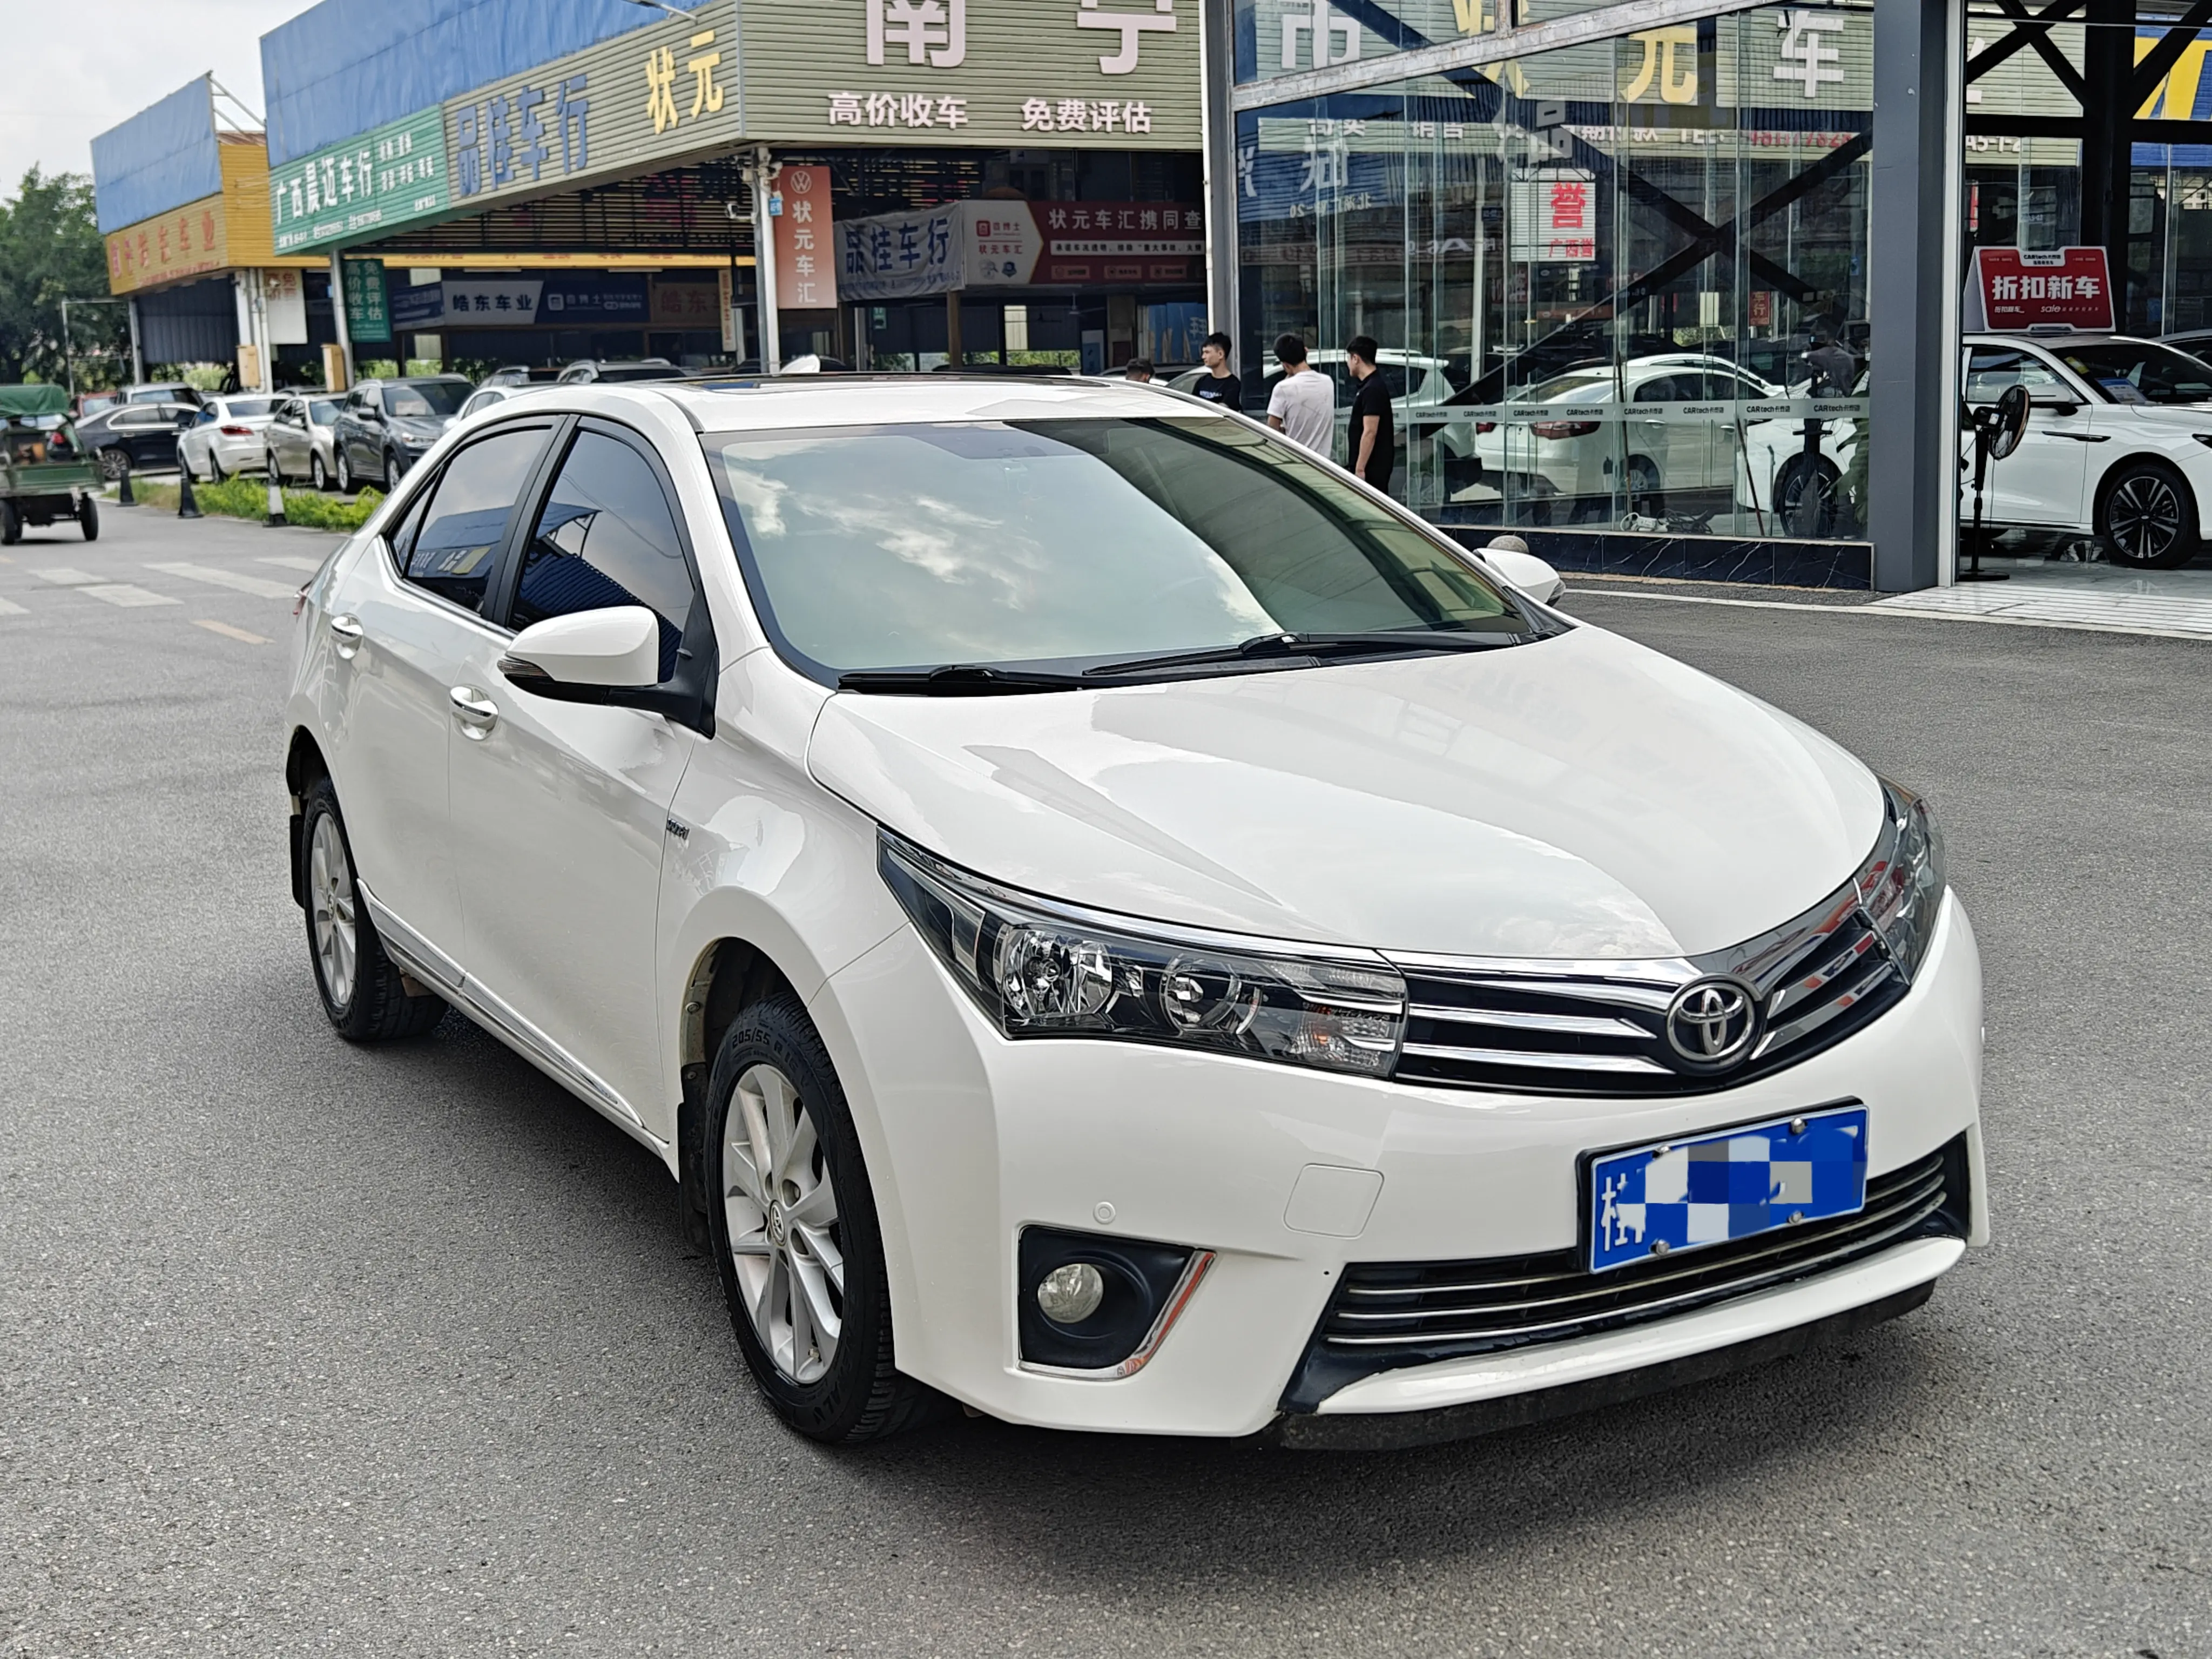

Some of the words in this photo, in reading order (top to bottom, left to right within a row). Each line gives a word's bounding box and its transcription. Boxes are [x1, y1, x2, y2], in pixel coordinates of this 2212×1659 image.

[646, 30, 724, 134] 状元
[827, 92, 969, 130] 高价收车
[1021, 97, 1152, 133] 免费评估
[1048, 208, 1202, 231] 状元车汇携同查
[792, 200, 817, 304] 状元车汇
[1992, 275, 2101, 300] 折扣新车
[732, 1027, 771, 1049] 205/55
